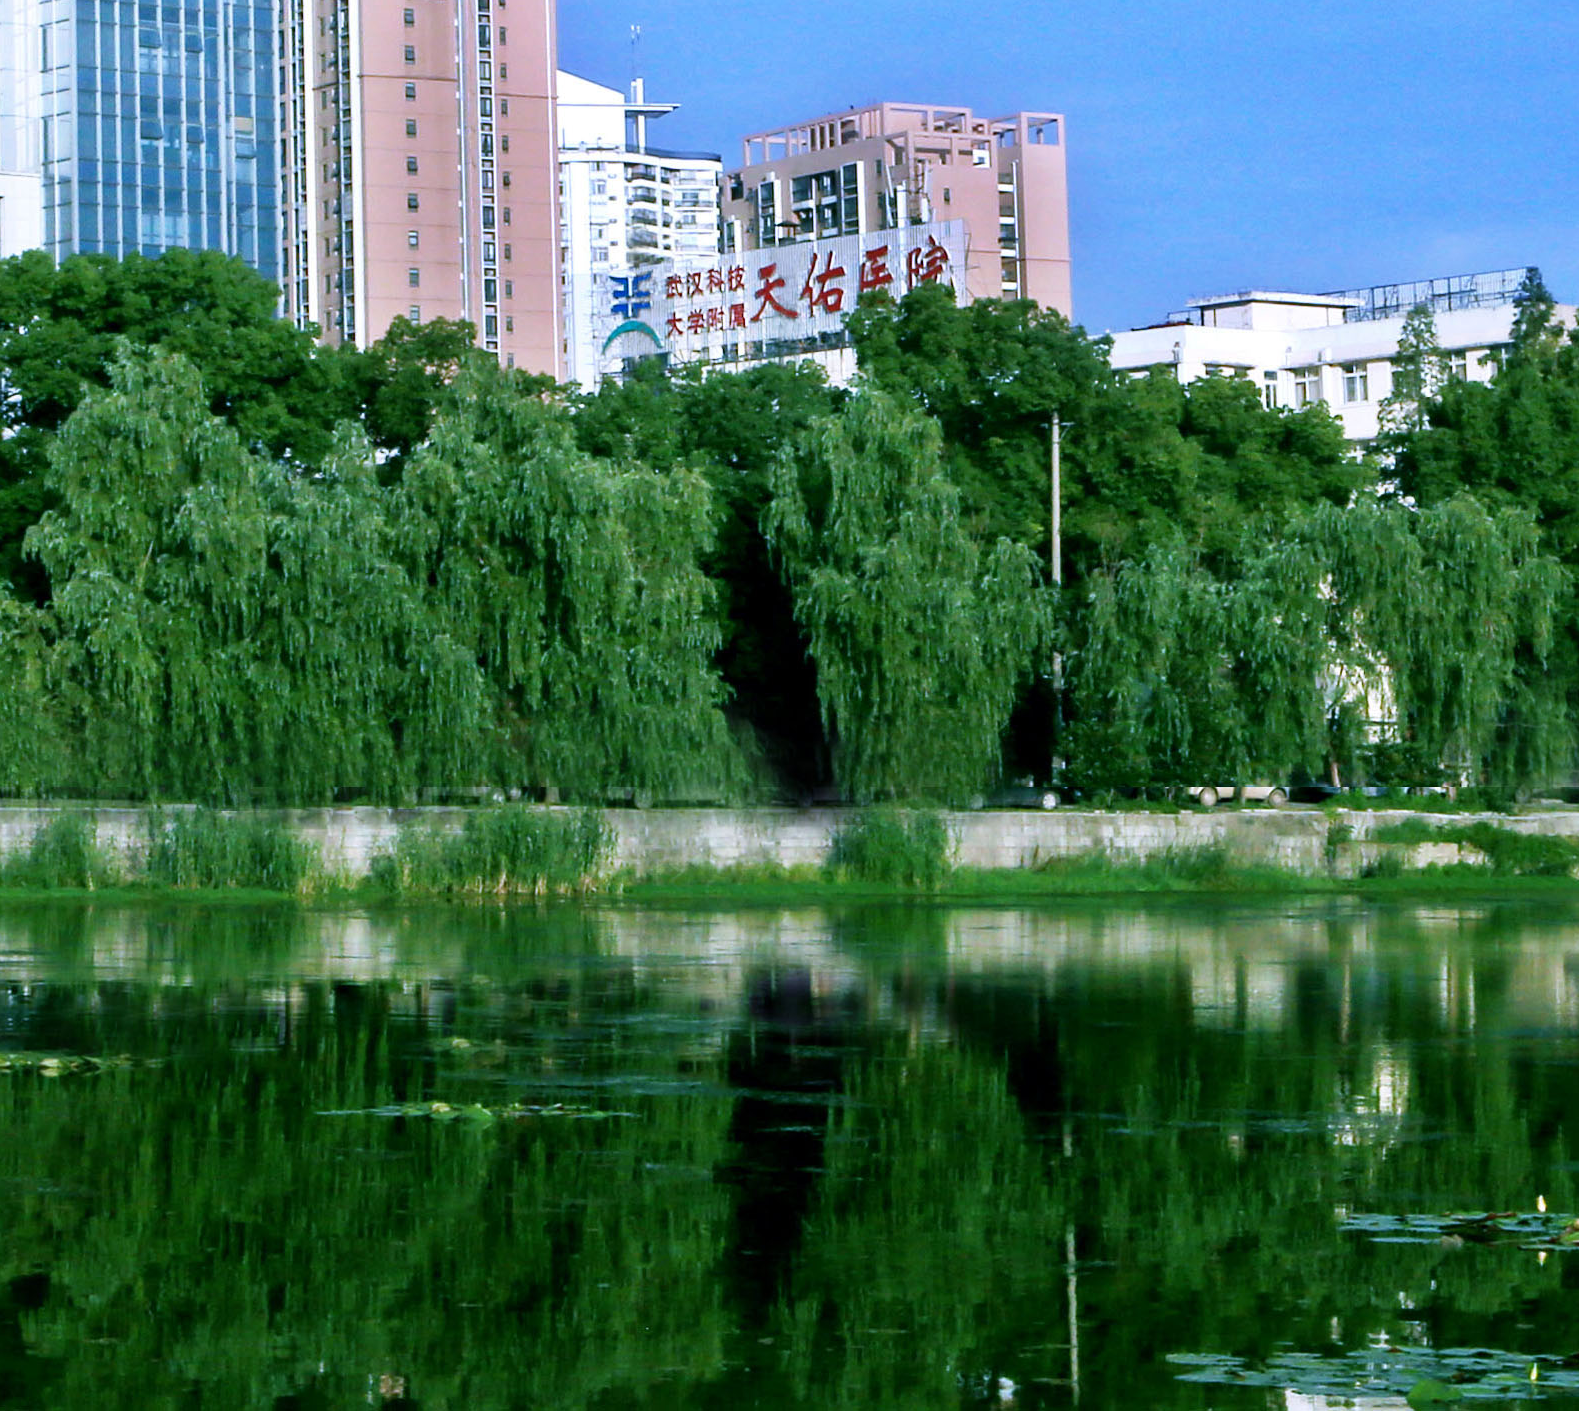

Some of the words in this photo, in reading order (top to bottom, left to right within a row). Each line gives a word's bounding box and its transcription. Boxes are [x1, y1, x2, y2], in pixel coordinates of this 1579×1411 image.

[666, 265, 745, 299] 武汉科技
[751, 234, 955, 322] 天佑医院
[665, 303, 746, 338] 大学附属
